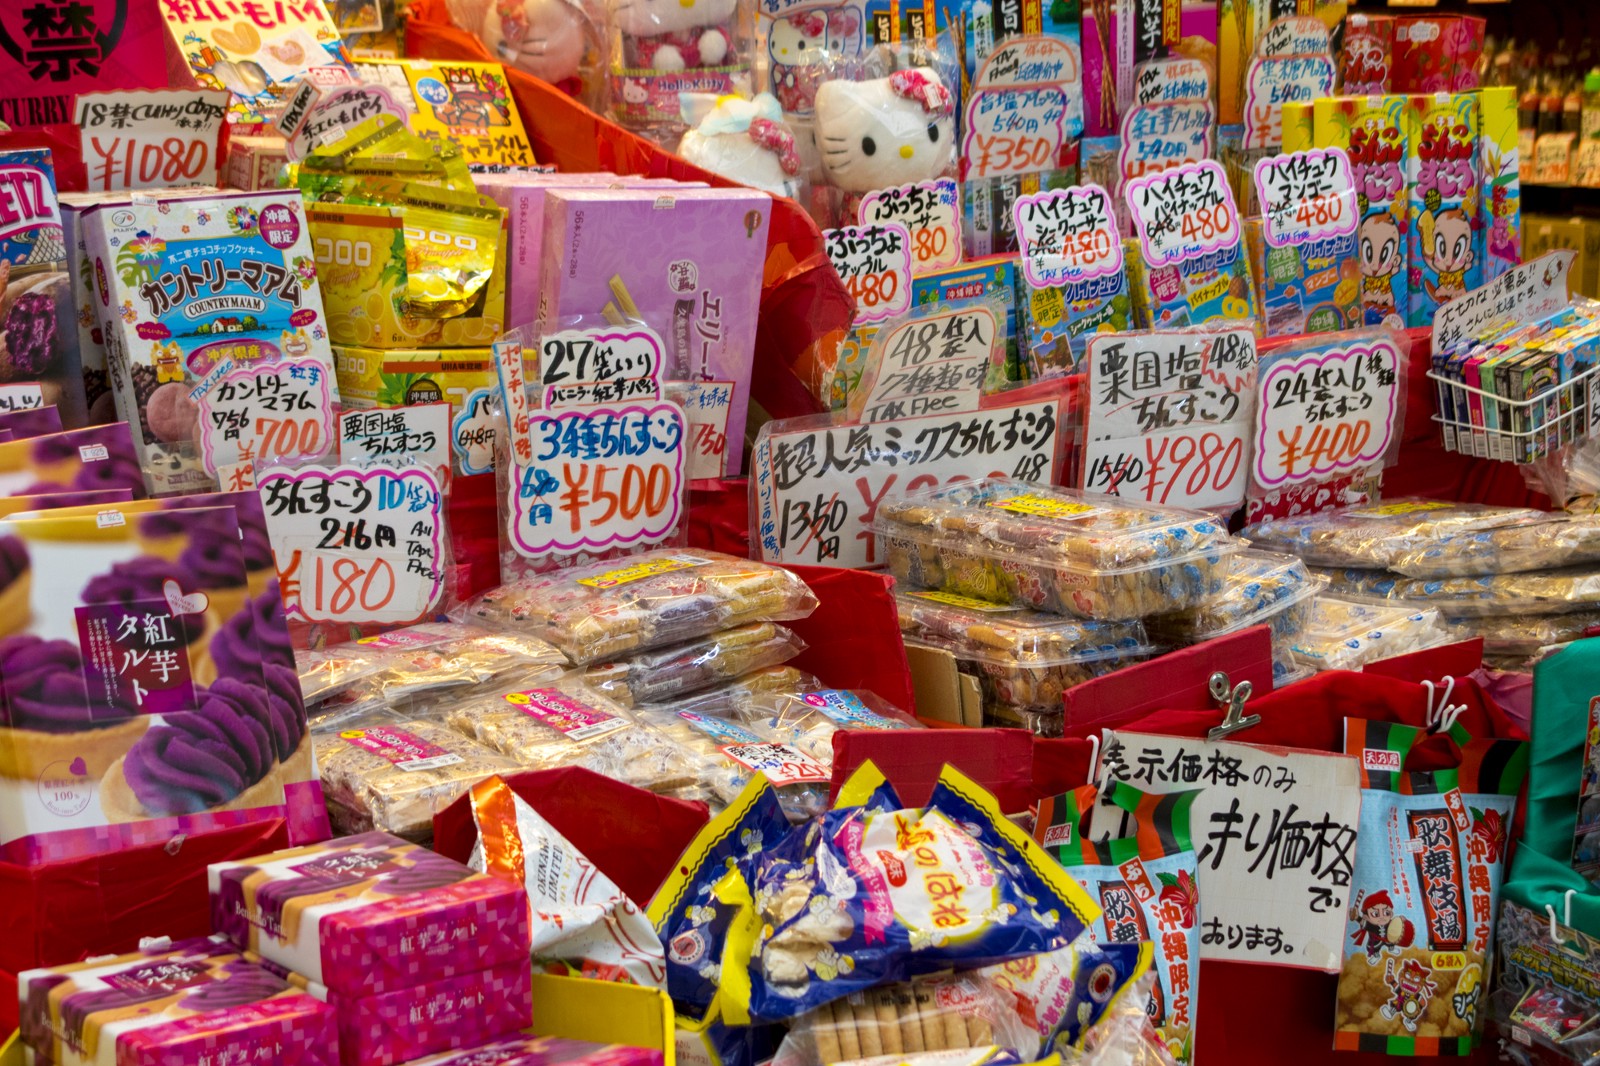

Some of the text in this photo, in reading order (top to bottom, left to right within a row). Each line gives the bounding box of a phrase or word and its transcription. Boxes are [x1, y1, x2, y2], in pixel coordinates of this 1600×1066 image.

[22, 1, 100, 82] 禁
[0, 95, 70, 128] CURRY
[91, 136, 209, 191] ¥1080
[975, 133, 1051, 177] ¥350
[1268, 152, 1338, 185] ハイチュウ
[874, 185, 938, 221] ぷっちょ
[1143, 168, 1215, 207] ハイチュウ
[1278, 179, 1333, 201] マンゴー
[265, 207, 291, 223] 沖縄
[1028, 189, 1105, 222] ハイチュウ
[1154, 189, 1225, 223] パイナップル
[1181, 202, 1231, 243] 480
[1295, 191, 1343, 228] 480
[268, 229, 295, 245] 限定
[827, 226, 902, 260] ぷっちょ
[1062, 228, 1111, 267] 480
[167, 243, 264, 266] 不二家チョコチップクッキー
[1273, 262, 1297, 280] 限定
[140, 258, 303, 318] カントリーマアム
[1032, 286, 1059, 307] 沖縄
[1064, 271, 1124, 305] ハイチュウ
[1155, 278, 1181, 299] 限定
[1305, 271, 1337, 290] マンゴー
[188, 297, 230, 317] COUNTRY
[1036, 302, 1061, 322] 限定
[217, 374, 289, 402] カントリー
[289, 363, 321, 387] 紅芋
[1098, 341, 1204, 405] 粟国塩
[212, 407, 250, 428] 756
[257, 391, 317, 412] マアム
[1131, 386, 1240, 435] ちんすこう
[1305, 395, 1373, 425] ちんすこう
[343, 411, 408, 441] 粟国塩
[537, 413, 683, 461] 3種ちんすこう
[360, 431, 437, 459] ちんすこう
[772, 404, 1056, 492] 超人気ミックスちんすこう
[1277, 419, 1372, 475] ¥400
[1086, 452, 1144, 488] 1550
[1140, 432, 1243, 505] ¥980
[265, 477, 373, 516] ちんすこう
[559, 462, 672, 534] ¥500
[315, 516, 396, 551] 216円
[115, 612, 151, 707] タルト
[142, 612, 181, 684] 紅芋
[1364, 750, 1400, 766] 天乃屋
[1415, 817, 1461, 941] 歌舞伎揚
[1463, 833, 1492, 955] 沖縄限定
[1307, 886, 1341, 913] で
[1201, 917, 1294, 955] おります。
[1149, 898, 1190, 1028] 沖縄限定
